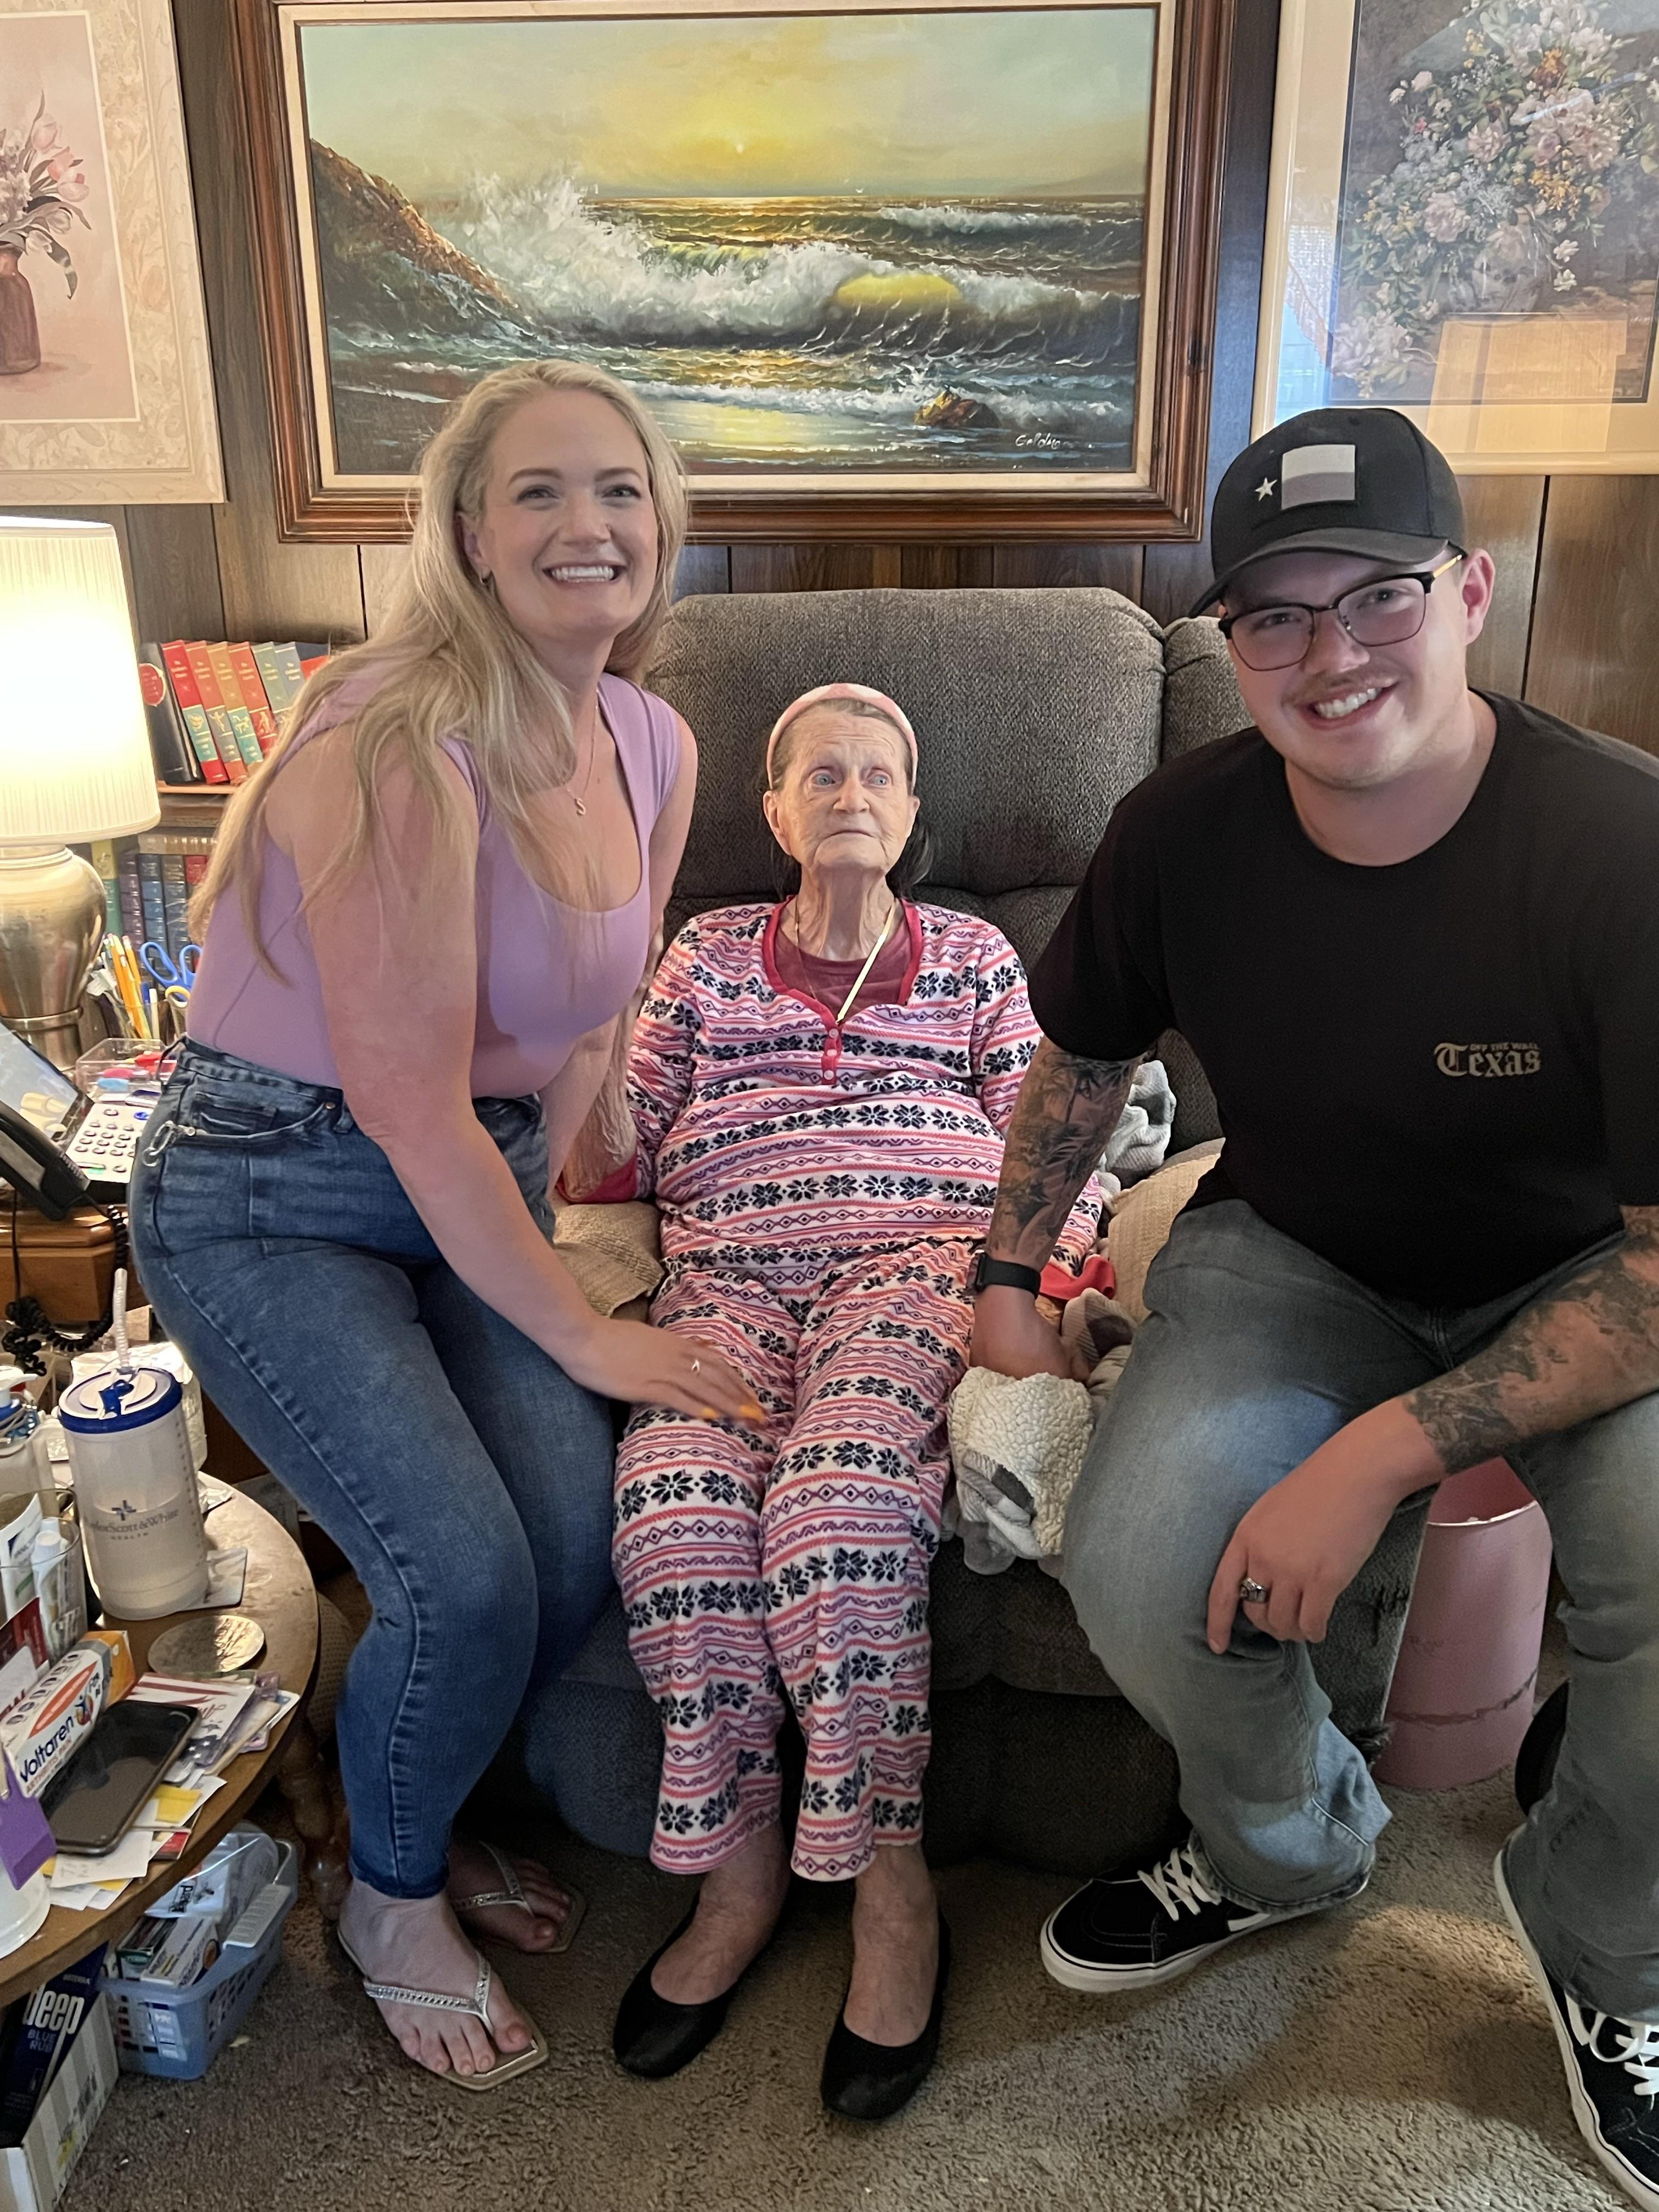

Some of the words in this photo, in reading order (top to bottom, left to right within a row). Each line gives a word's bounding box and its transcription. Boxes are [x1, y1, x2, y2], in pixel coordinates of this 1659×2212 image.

[1434, 1042, 1541, 1077] Texas
[20, 1716, 75, 1783] Voltaren
[27, 2028, 57, 2042] BLUE
